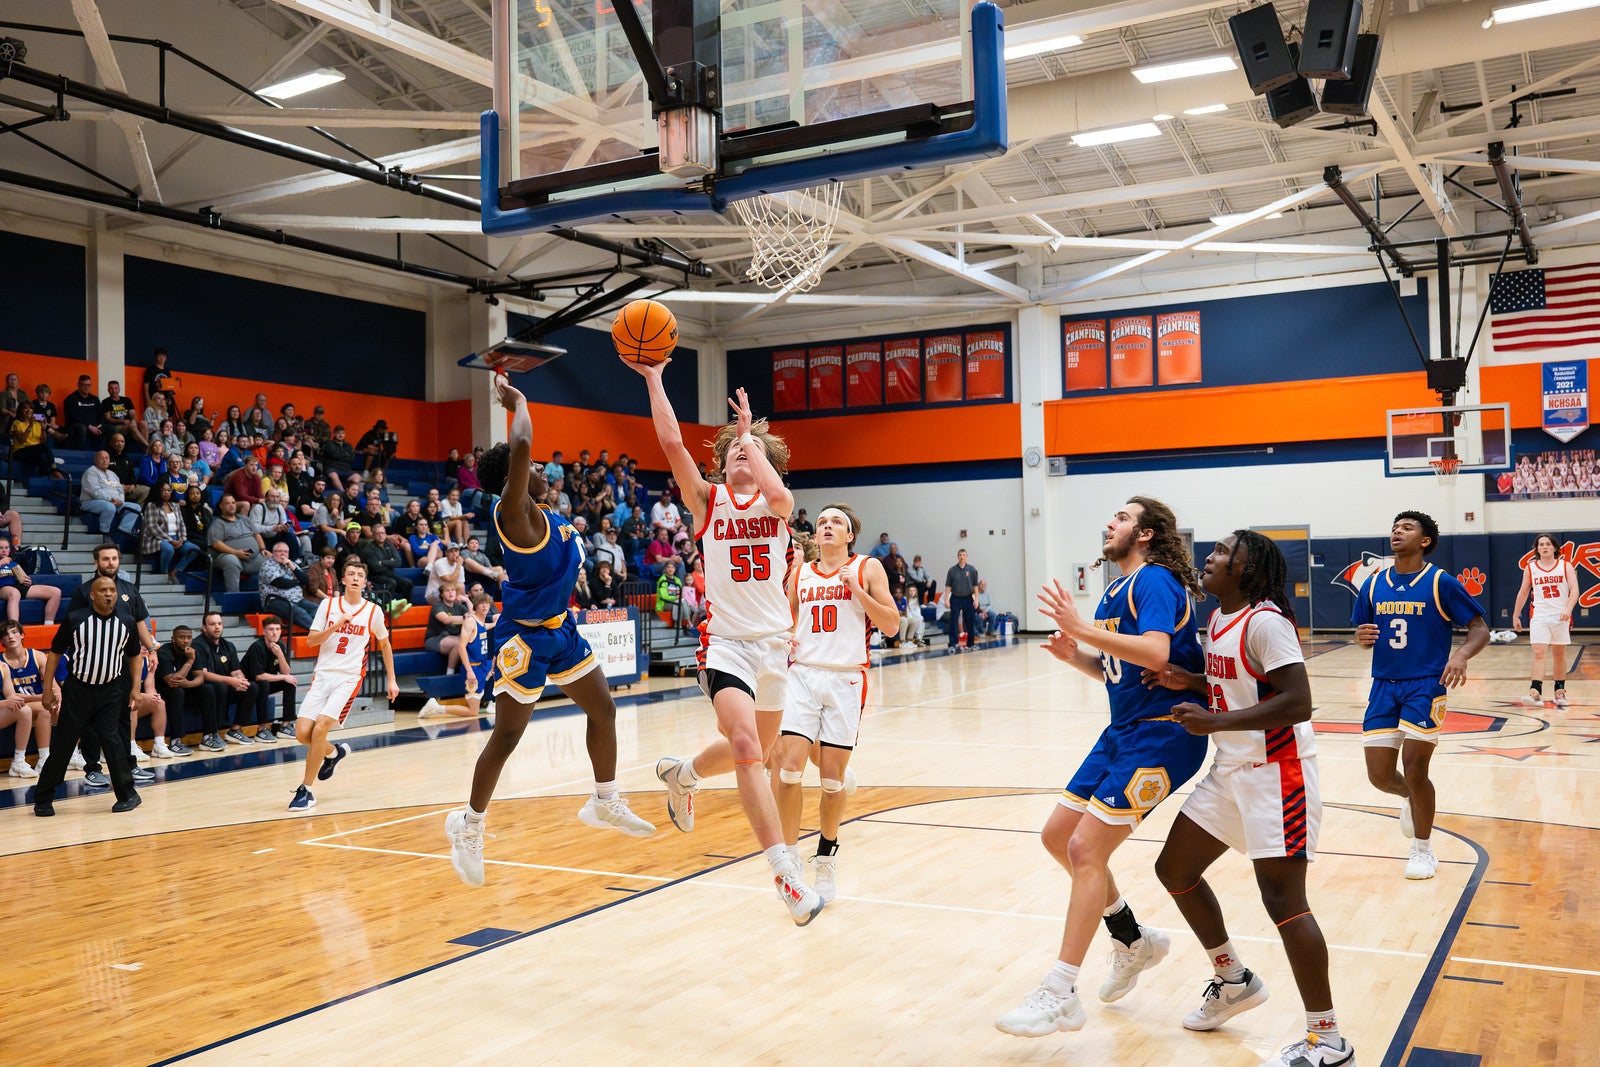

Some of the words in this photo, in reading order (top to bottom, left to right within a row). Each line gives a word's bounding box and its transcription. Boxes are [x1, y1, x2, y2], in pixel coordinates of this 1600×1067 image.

[1065, 328, 1105, 345] CHAMPIONS
[1111, 325, 1152, 342] CHAMPIONS
[1158, 321, 1199, 338] CHAMPIONS
[885, 347, 920, 361] CHAMPIONS
[925, 343, 962, 360] CHAMPIONS
[966, 339, 1005, 356] CHAMPIONS
[773, 358, 806, 372] CHAMPIONS
[809, 355, 843, 369] CHAMPIONS
[847, 351, 881, 365] CHAMPIONS
[1556, 381, 1574, 389] 2021
[1548, 398, 1582, 409] NCHSAA
[714, 516, 780, 541] CARSON
[730, 544, 771, 583] 55
[1534, 575, 1564, 586] CARSON
[799, 585, 852, 604] CARSON
[1541, 585, 1561, 599] 25
[586, 608, 628, 624] COUGARS
[1376, 601, 1426, 616] MOUNT
[811, 605, 838, 634] 10
[608, 632, 634, 647] Gary's
[1389, 618, 1408, 650] 3
[335, 636, 349, 655] 2
